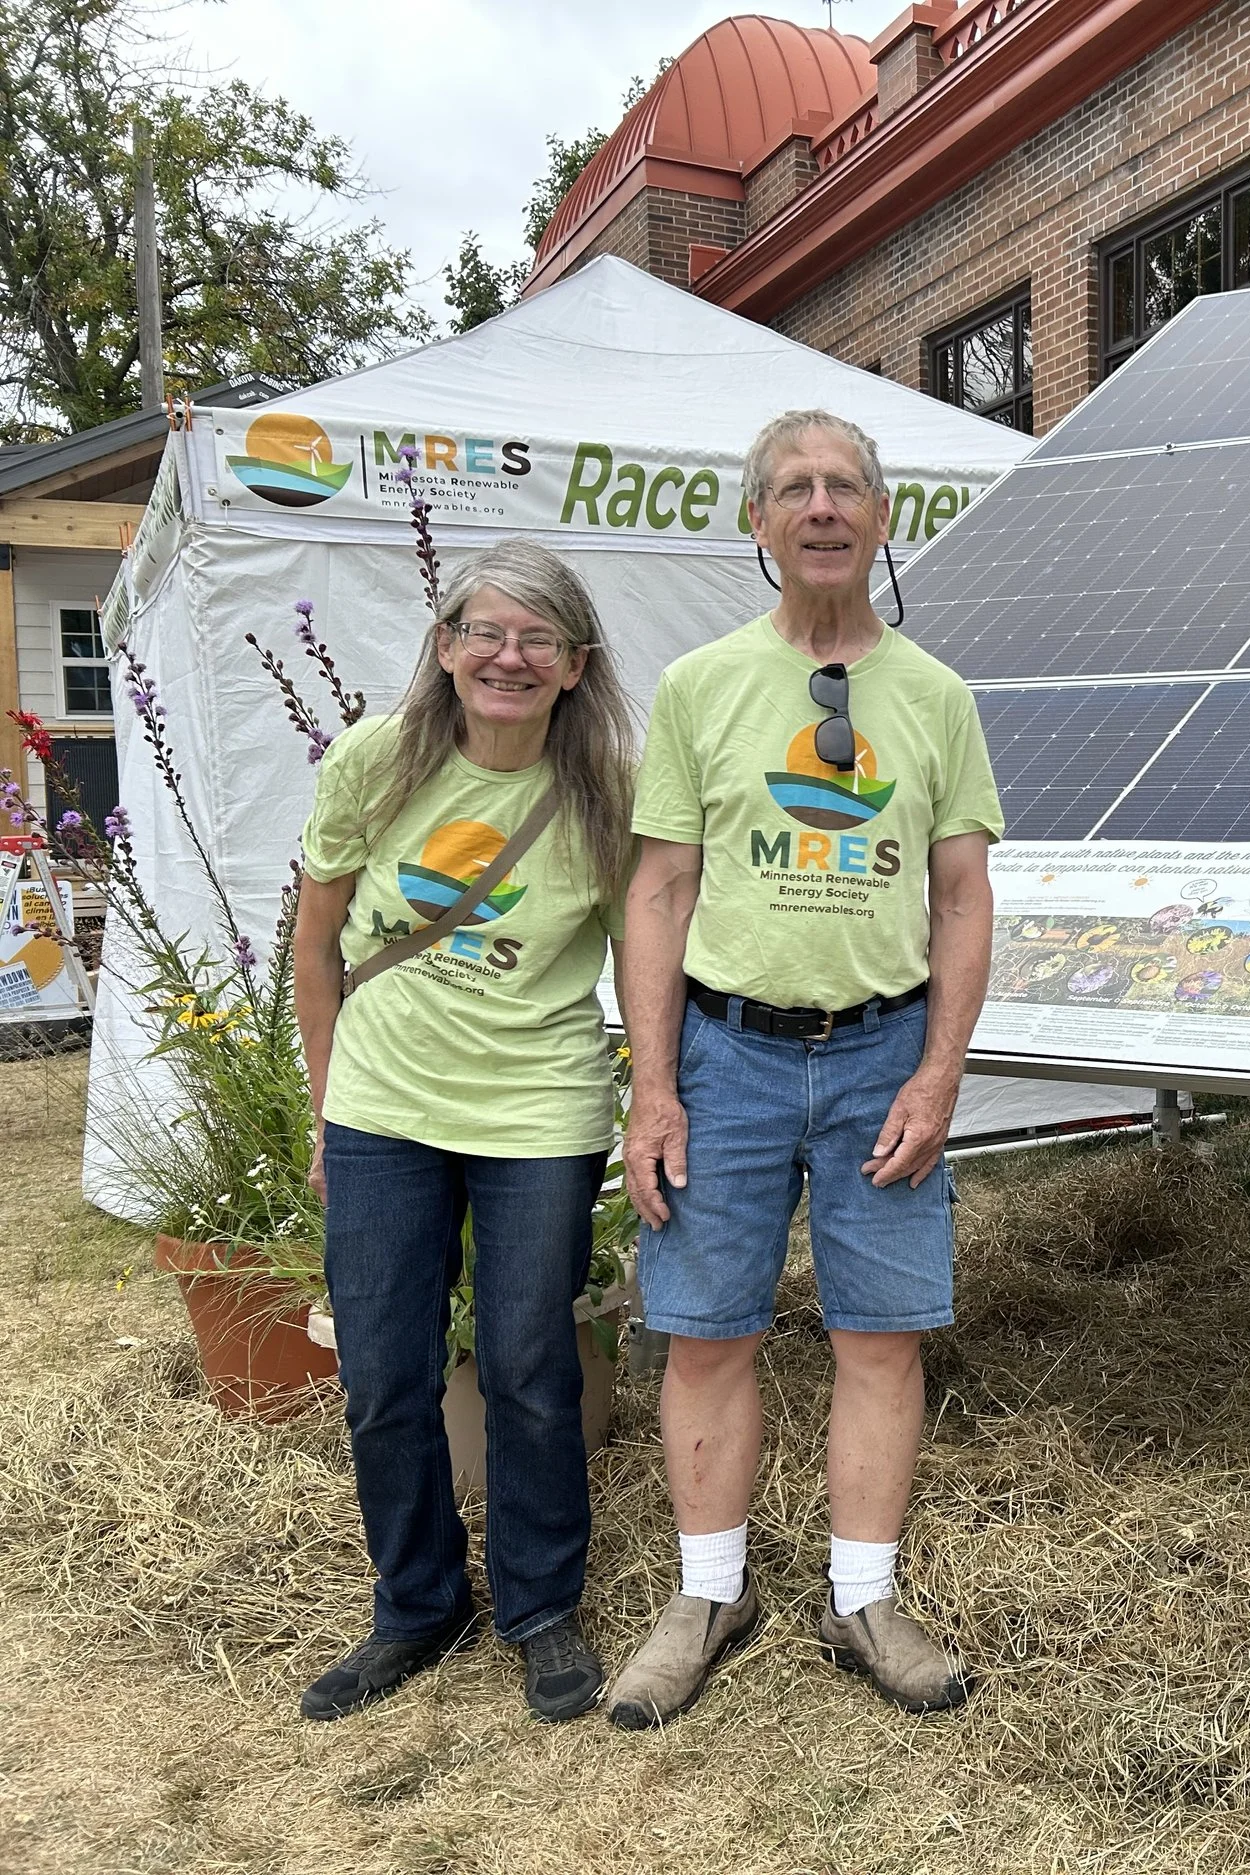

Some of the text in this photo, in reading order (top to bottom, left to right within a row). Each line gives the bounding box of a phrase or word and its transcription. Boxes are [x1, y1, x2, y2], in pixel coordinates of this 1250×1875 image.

[228, 372, 285, 392] DAKOTA CABINS
[373, 430, 532, 476] MRES
[379, 484, 477, 500] Energy Society
[451, 477, 520, 490] Renewable
[560, 441, 719, 532] Race
[751, 829, 901, 877] MRES
[992, 849, 1016, 858] all
[1013, 850, 1060, 858] season
[1060, 849, 1092, 858] with
[1092, 849, 1137, 858] native
[1133, 849, 1182, 861] plants
[1183, 850, 1217, 860] and
[1215, 850, 1240, 860] the
[990, 862, 1023, 872] toda
[1023, 863, 1040, 872] la
[1040, 862, 1117, 874] temporada
[1117, 865, 1146, 873] con
[1142, 864, 1202, 876] plantas
[759, 870, 890, 889] Minnesota Renewable
[779, 886, 869, 902] Energy Society
[769, 902, 875, 918] mnrenewables.org
[371, 908, 523, 970] MES
[434, 953, 501, 980] Renewable
[1067, 994, 1113, 1003] September
